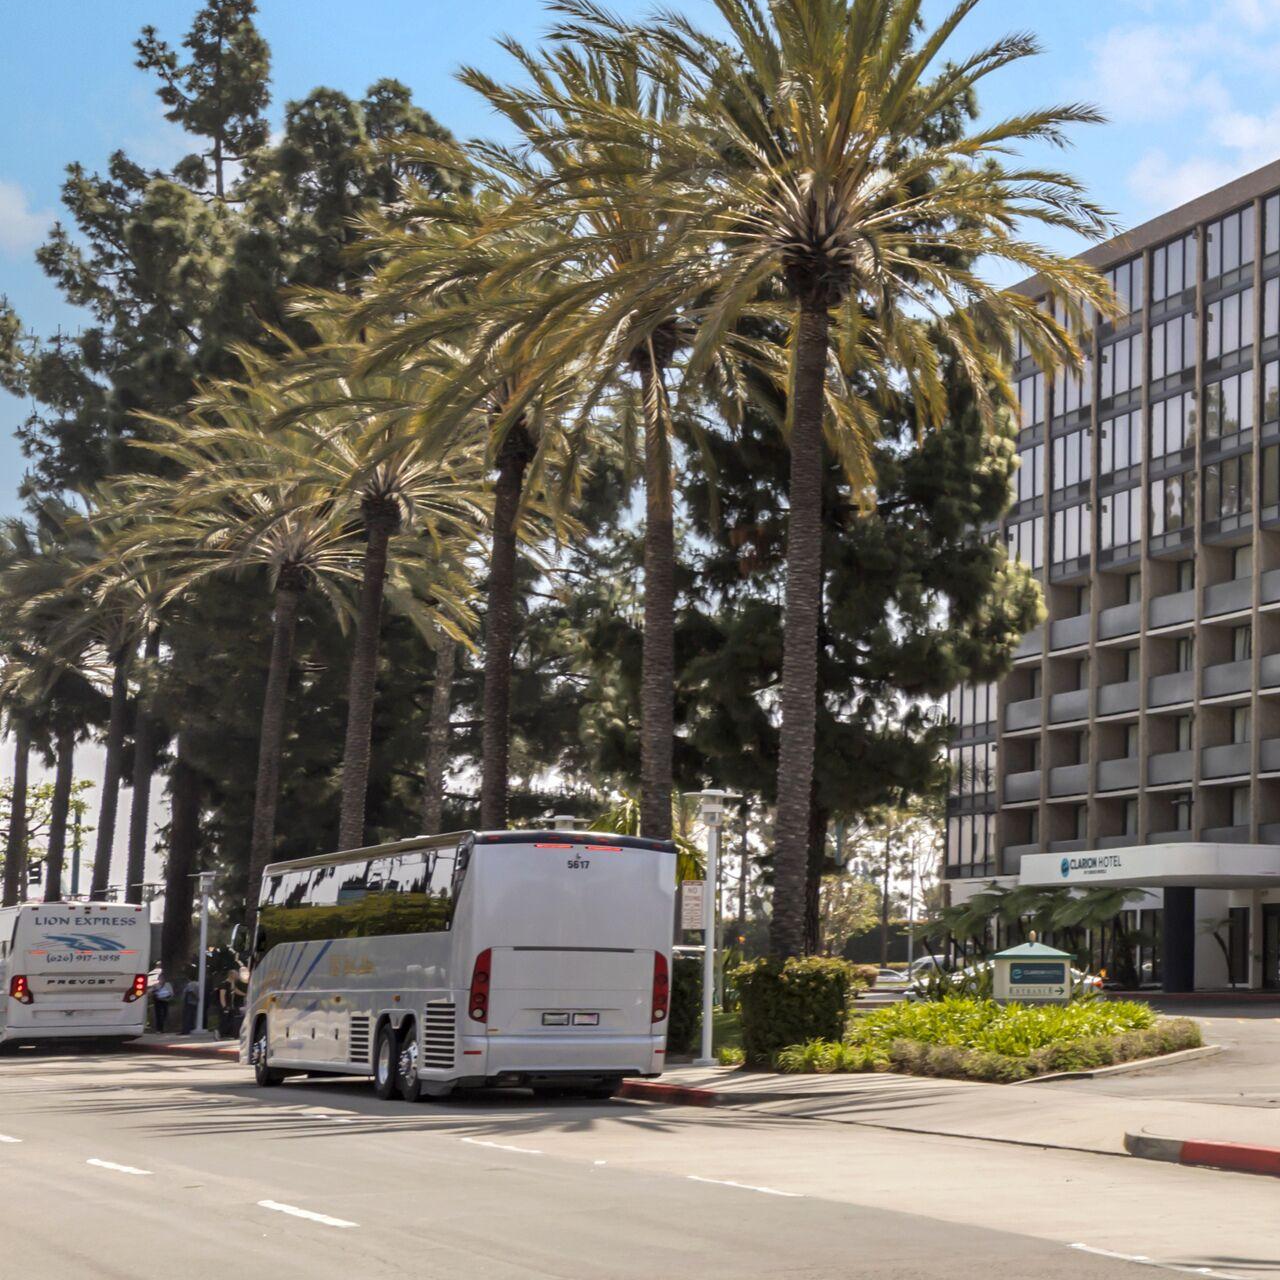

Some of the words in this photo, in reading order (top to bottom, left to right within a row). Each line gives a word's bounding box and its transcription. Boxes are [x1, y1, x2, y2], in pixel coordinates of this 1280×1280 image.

[568, 861, 590, 869] 5617
[1070, 858, 1097, 870] CLARION
[1098, 855, 1122, 868] HOTEL
[35, 917, 70, 926] LION
[75, 917, 136, 926] EXPRESS
